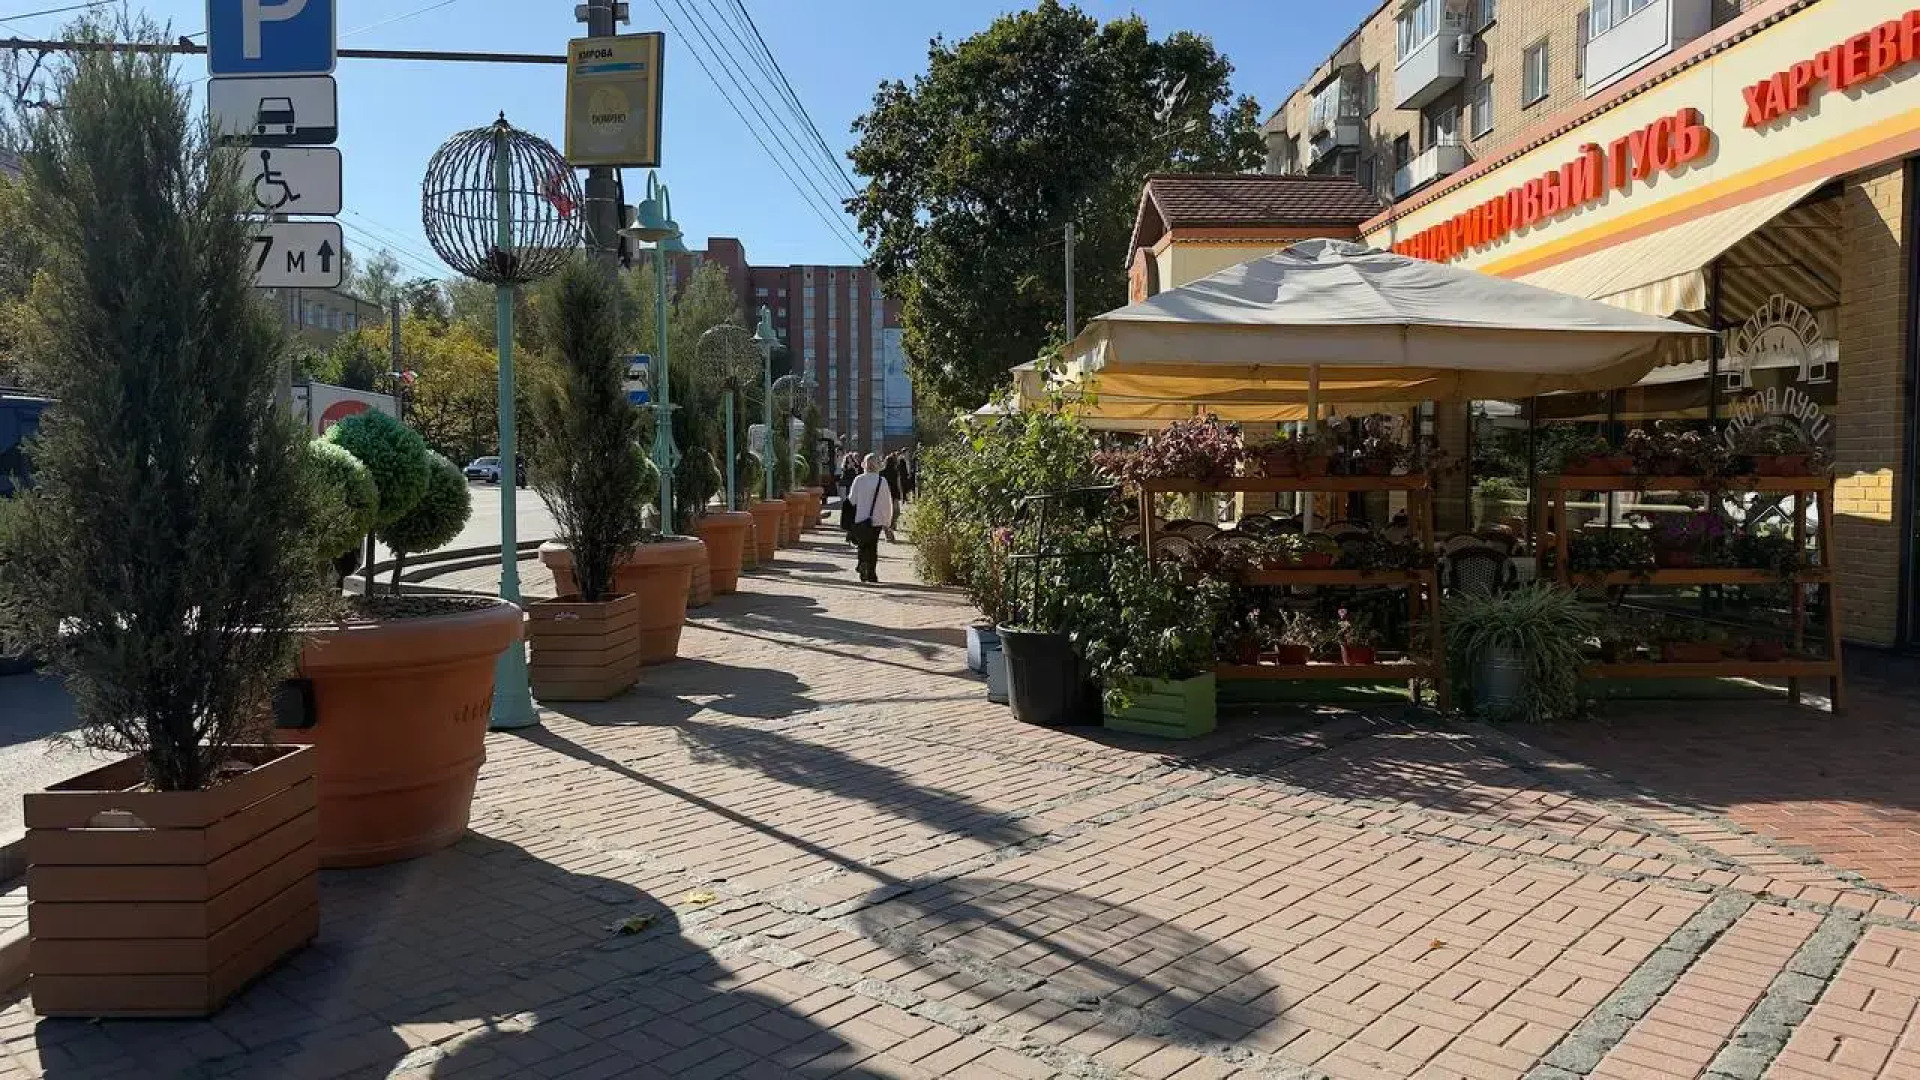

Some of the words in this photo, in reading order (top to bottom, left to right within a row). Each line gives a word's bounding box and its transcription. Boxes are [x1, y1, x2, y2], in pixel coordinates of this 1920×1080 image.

[243, 0, 308, 59] P
[1392, 143, 1603, 263] НДАРИНОВЫЙ
[1608, 107, 1711, 190] ГУСЬ
